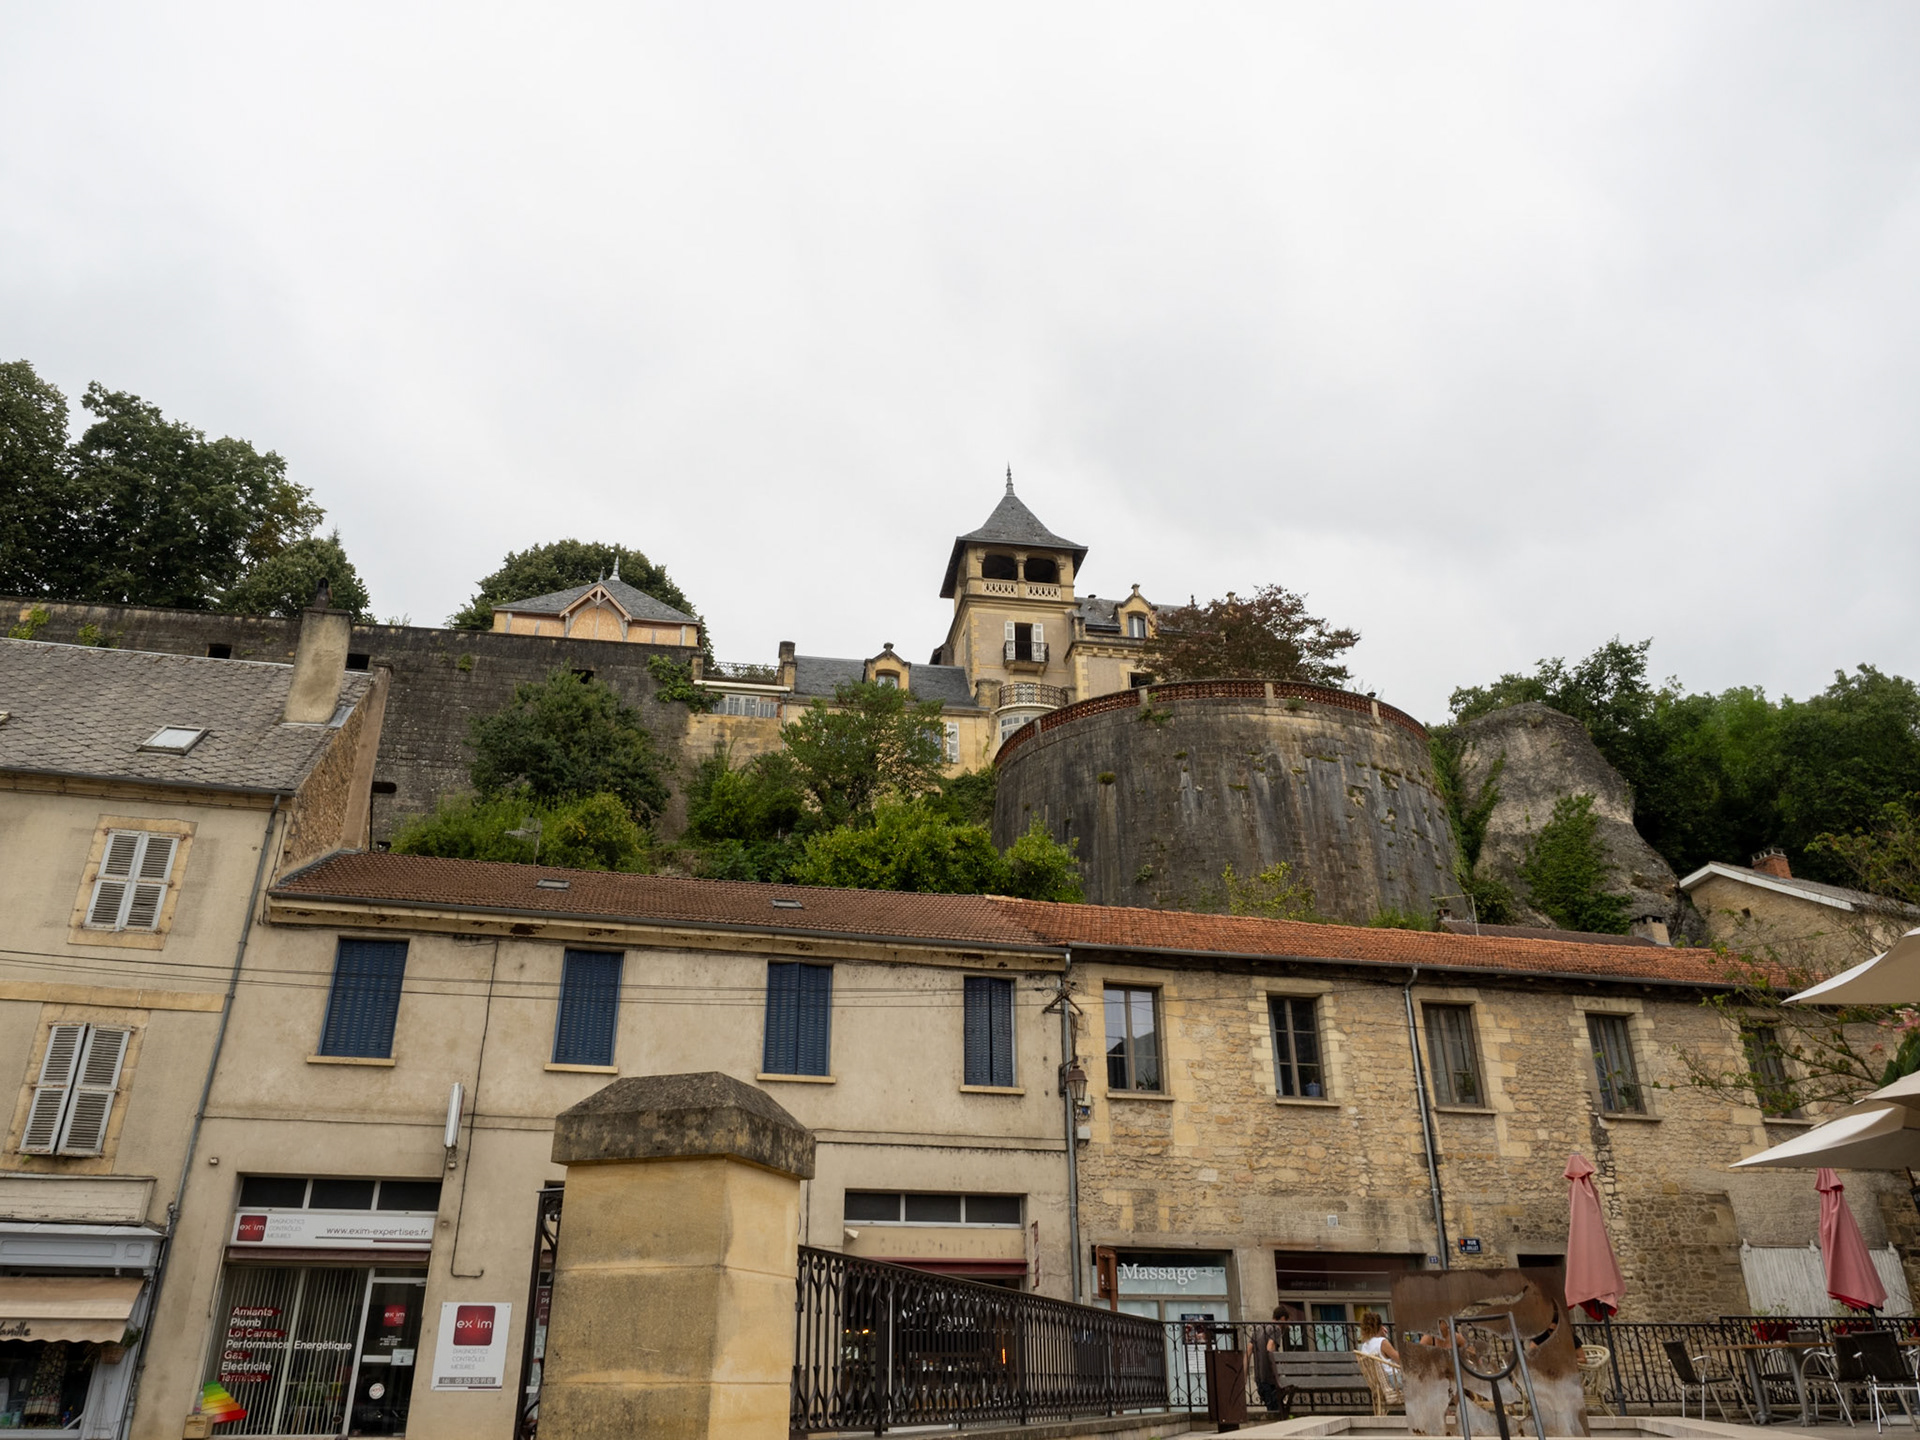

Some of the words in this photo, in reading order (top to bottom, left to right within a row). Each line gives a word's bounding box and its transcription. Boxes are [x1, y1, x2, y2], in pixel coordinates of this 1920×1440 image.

[326, 1226, 429, 1237] www.exim-expertises.fr
[1121, 1262, 1197, 1285] Massage
[232, 1307, 274, 1316] Amiante
[230, 1318, 261, 1327] Plomb
[228, 1329, 244, 1337] Loi
[246, 1329, 278, 1338] Carrez
[226, 1340, 289, 1349] Performance
[224, 1351, 243, 1359] Gaz
[222, 1362, 272, 1371] Electricité
[221, 1373, 262, 1382] Termites
